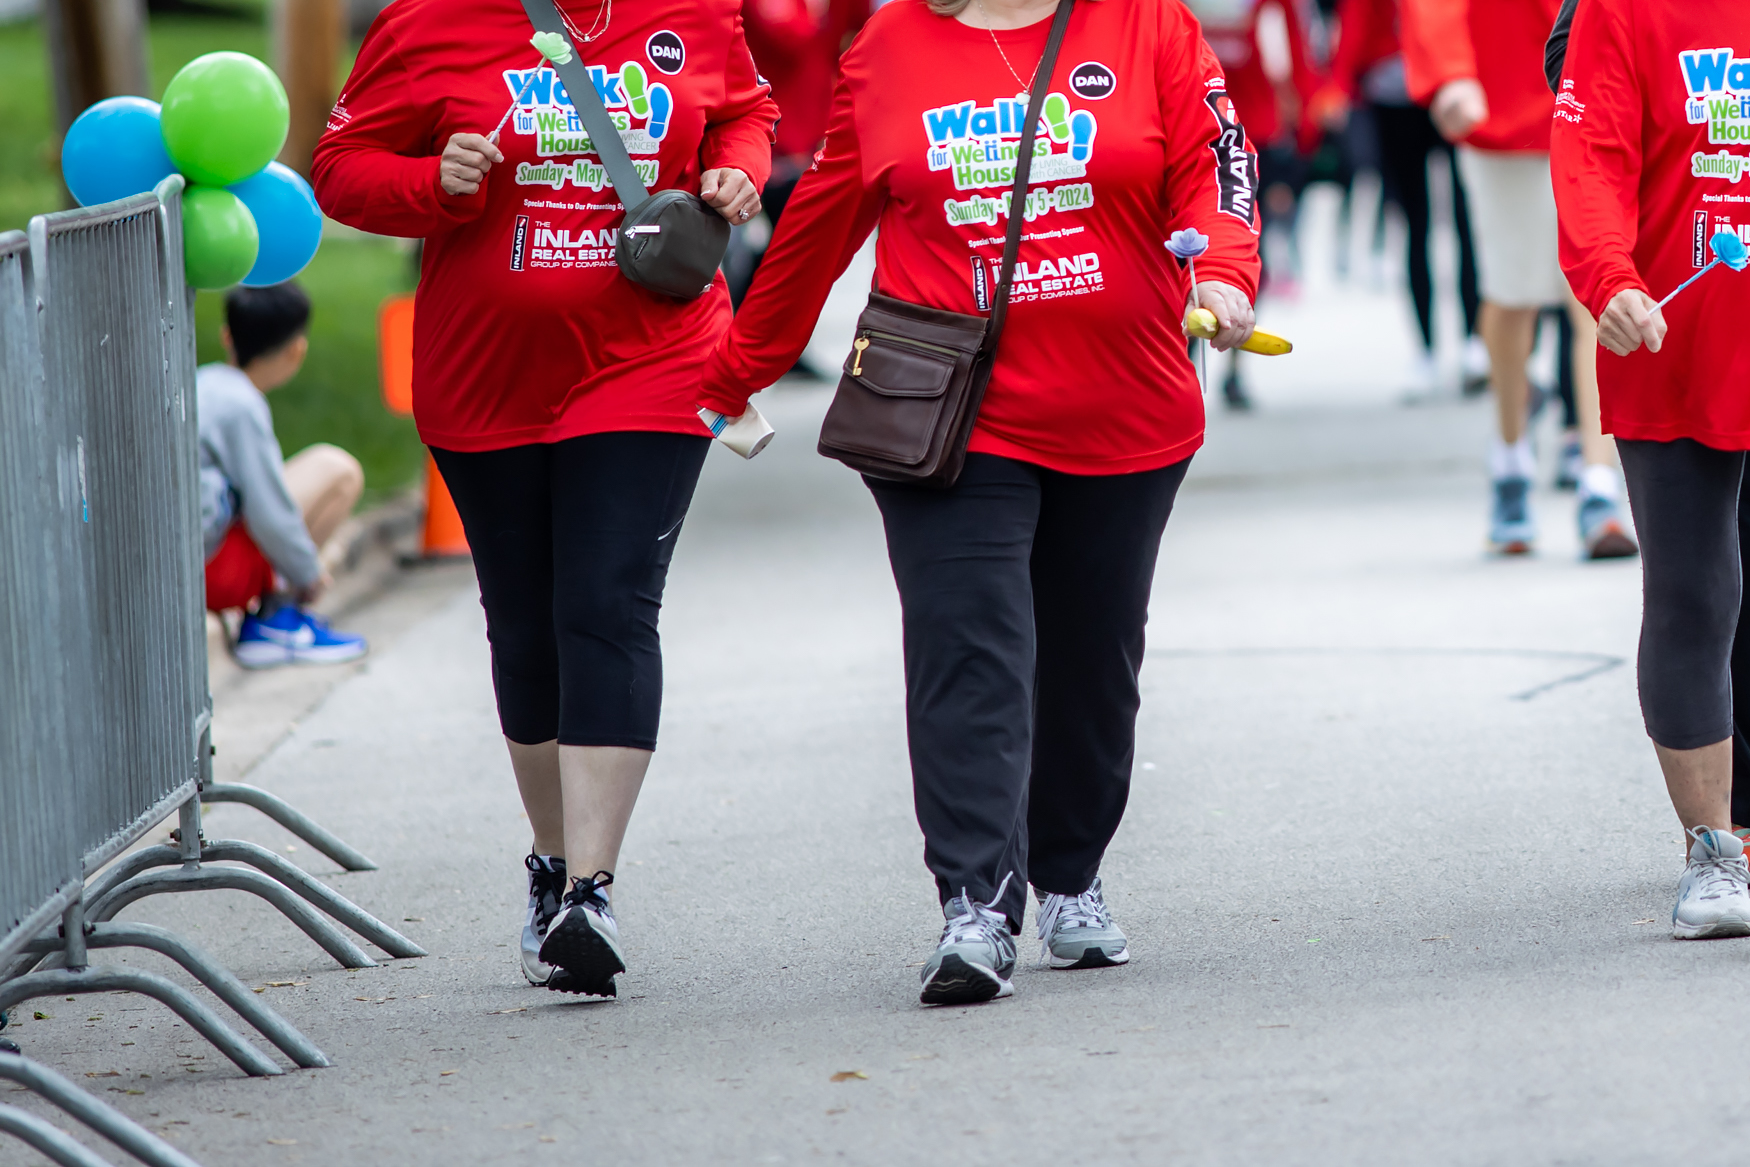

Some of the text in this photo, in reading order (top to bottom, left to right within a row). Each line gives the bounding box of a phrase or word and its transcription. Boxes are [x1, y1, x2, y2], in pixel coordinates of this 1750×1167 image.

[651, 45, 681, 60] DAN
[508, 69, 622, 105] Wak
[1075, 76, 1109, 87] DAN
[1689, 102, 1705, 119] for
[518, 113, 533, 130] for
[932, 150, 947, 166] for
[1040, 157, 1068, 168] LIVING
[520, 163, 564, 185] Sunday
[576, 163, 603, 187] May
[1047, 165, 1082, 176] CANCER
[1695, 155, 1740, 179] Sunday
[524, 198, 544, 207] Special
[546, 201, 566, 209] Thanks
[575, 202, 585, 210] Our
[587, 203, 616, 211] Presenting
[948, 199, 994, 221] Sunday
[1038, 192, 1045, 210] 5
[1058, 186, 1090, 207] 2024
[1702, 194, 1723, 204] Special
[534, 228, 619, 248] INLAN
[513, 228, 524, 269] INLAND
[531, 249, 616, 260] REAL ESTA
[976, 267, 985, 309] INLAND
[1041, 272, 1103, 292] ESTATE
[1027, 293, 1039, 301] OF
[1040, 288, 1090, 300] COMPANIES,
